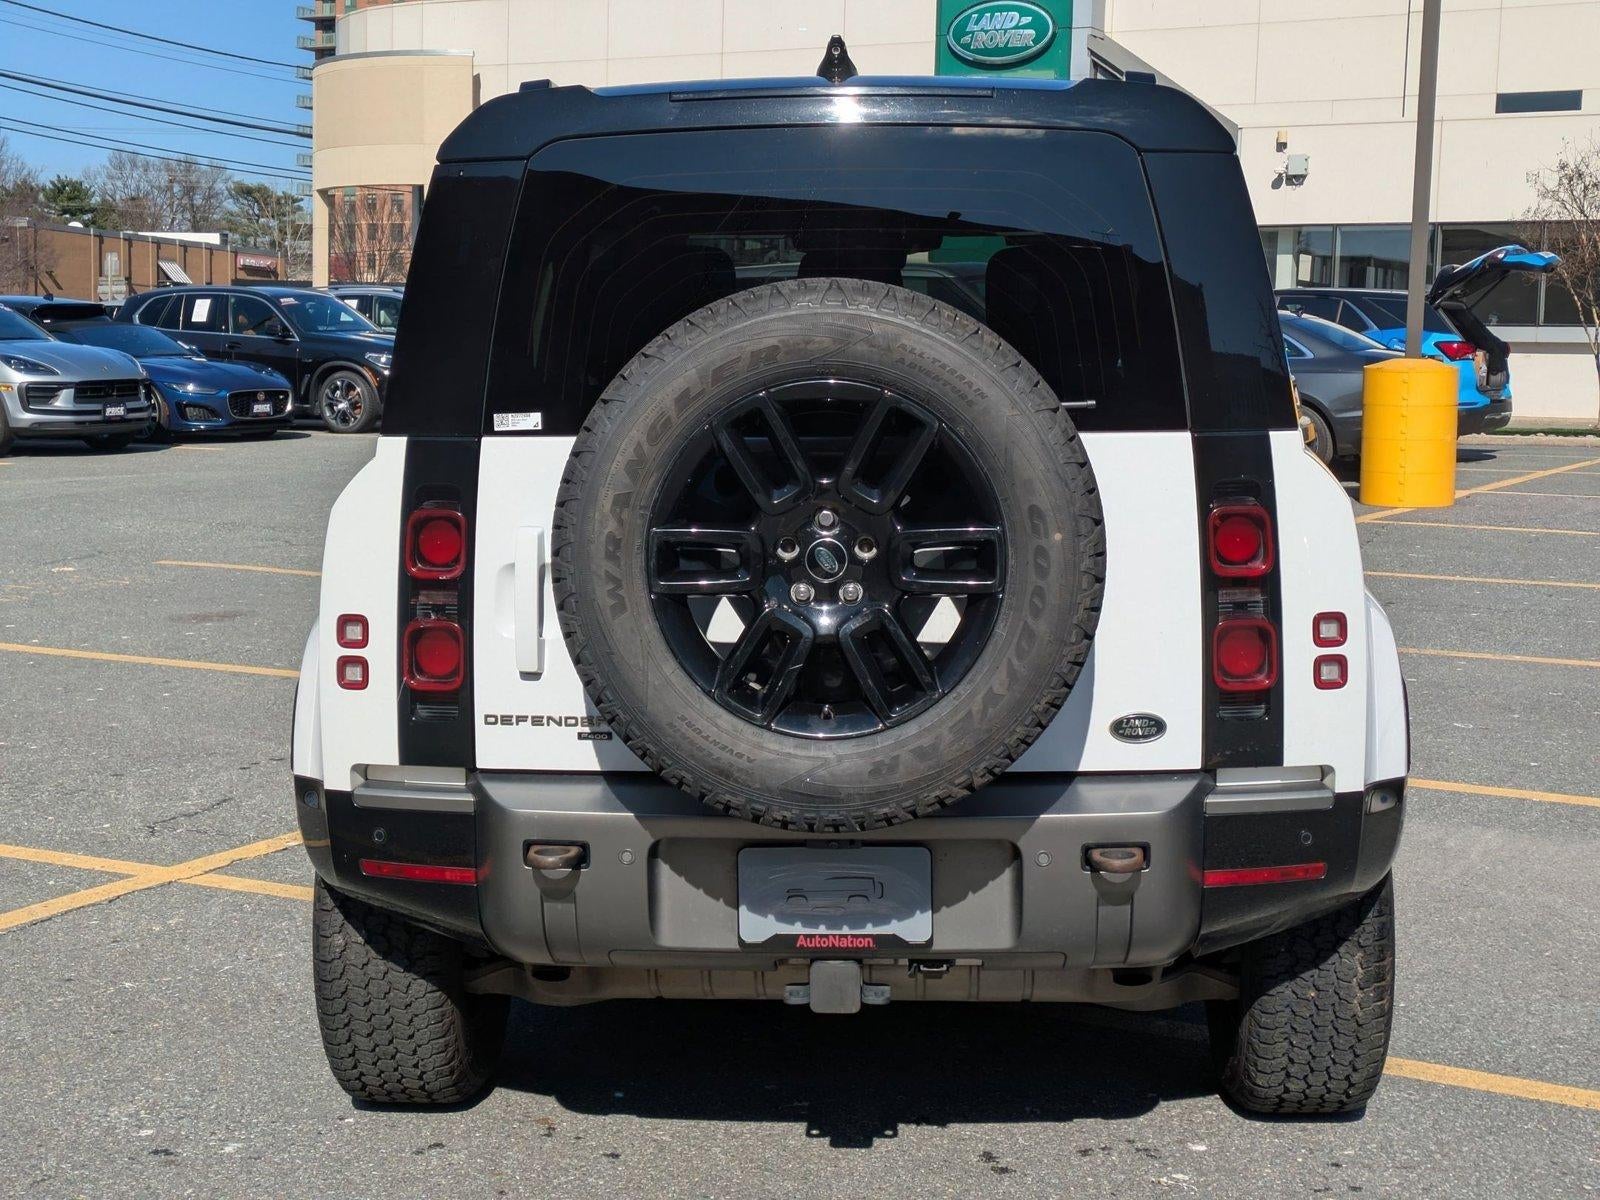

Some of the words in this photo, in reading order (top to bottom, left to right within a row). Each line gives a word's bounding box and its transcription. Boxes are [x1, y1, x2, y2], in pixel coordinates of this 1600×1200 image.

[966, 11, 1020, 31] LAND
[970, 29, 1035, 49] ROVER
[604, 343, 782, 620] WRANGLER
[1122, 719, 1149, 727] LAND
[1124, 727, 1157, 736] ROVER
[797, 935, 873, 948] AutoNation
